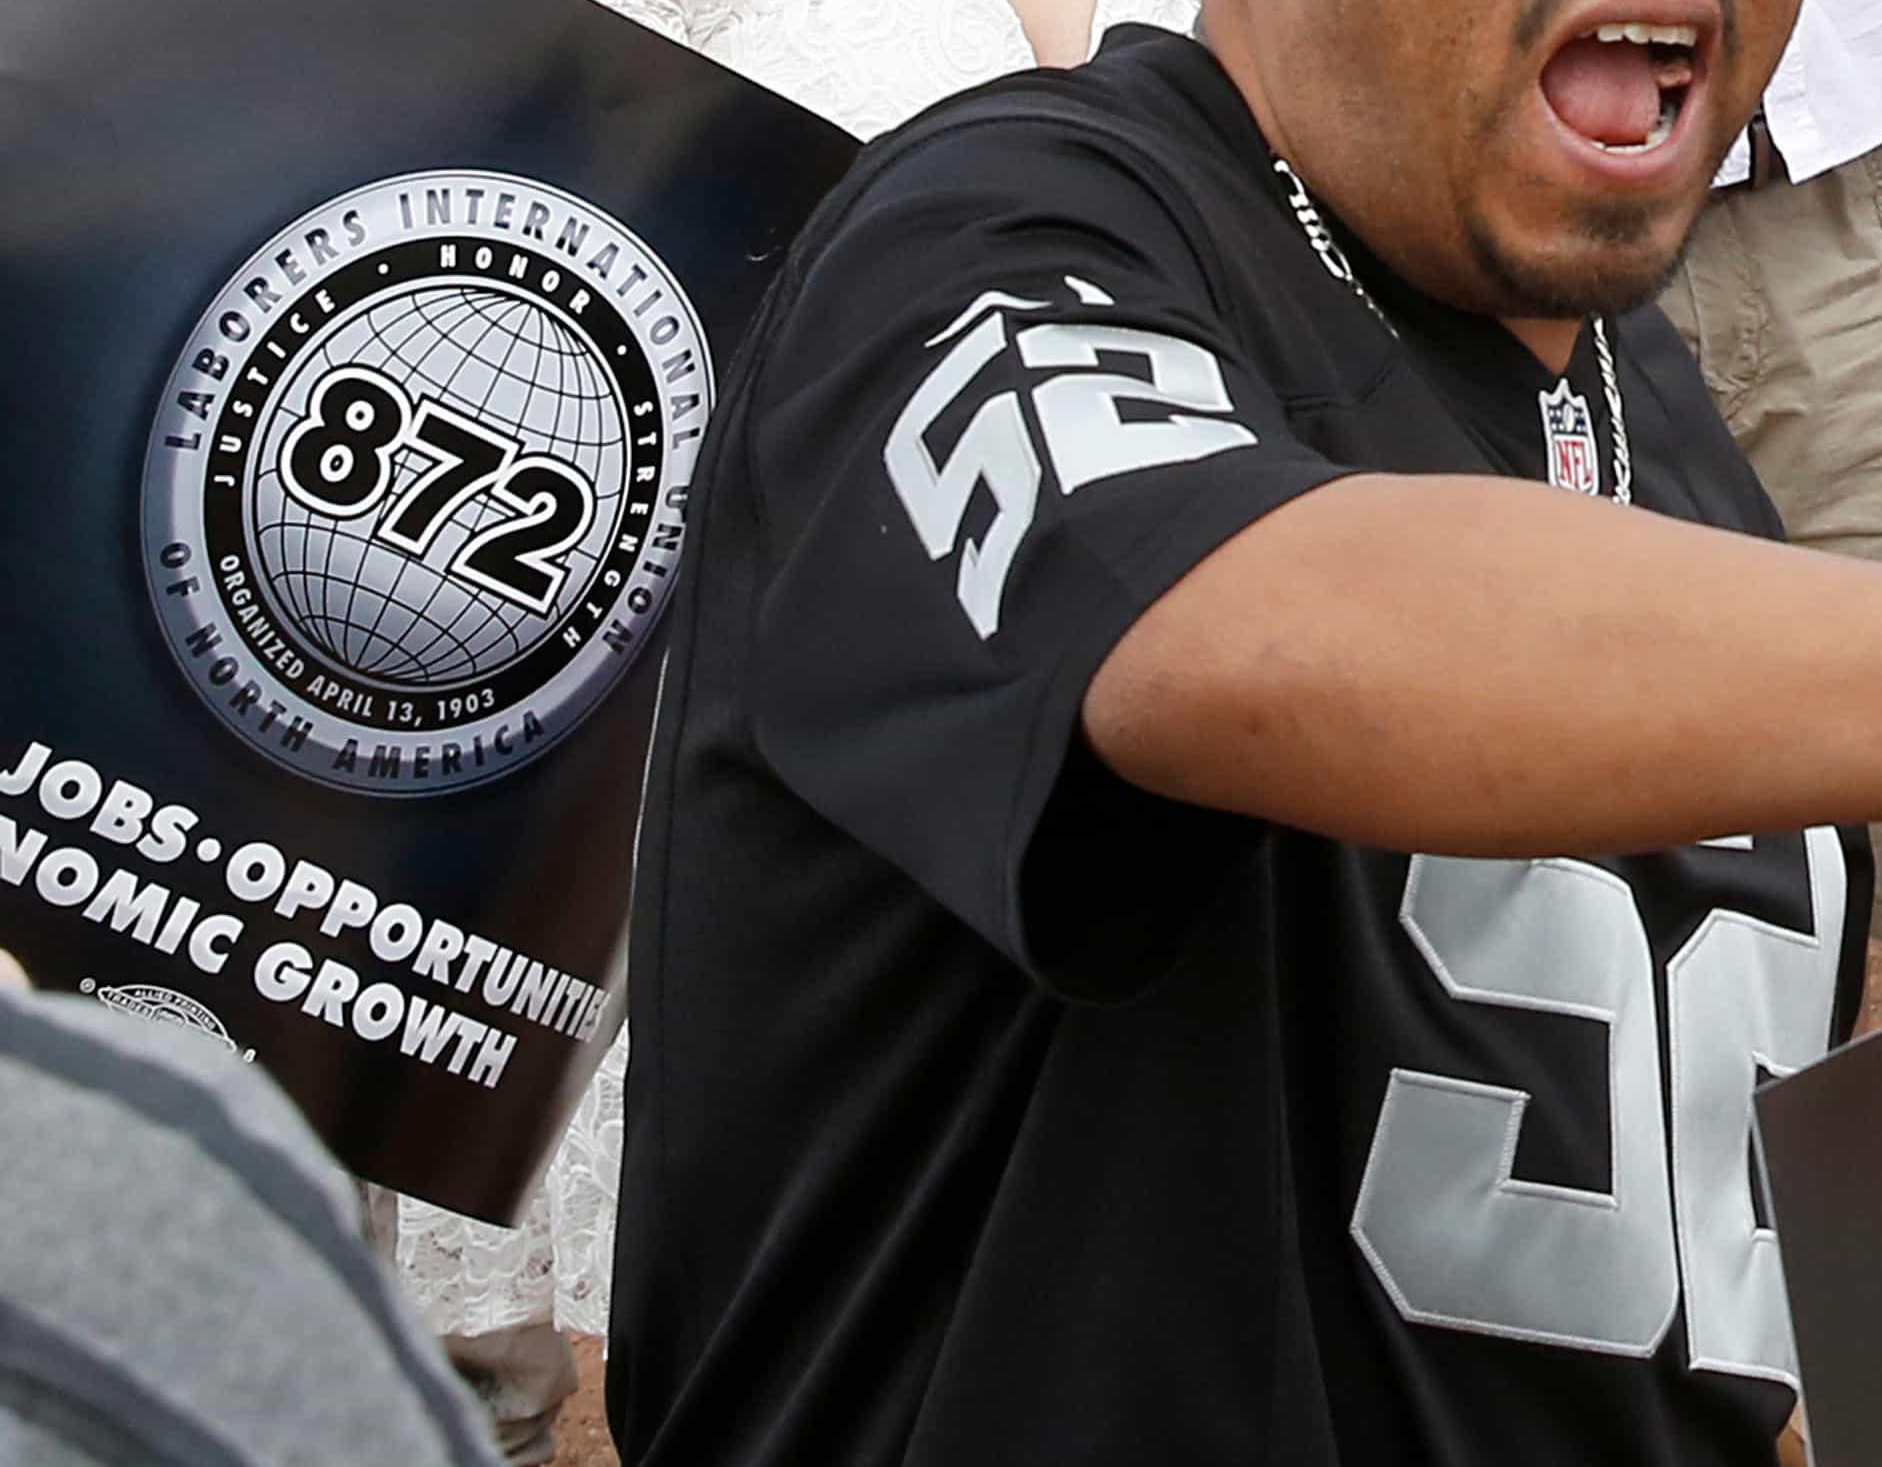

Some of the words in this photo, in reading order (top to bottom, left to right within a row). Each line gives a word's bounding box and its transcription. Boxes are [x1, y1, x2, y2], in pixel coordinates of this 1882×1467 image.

[164, 209, 367, 451] LABORERS
[399, 187, 701, 451] INTERNATIONAL
[602, 485, 689, 655] UNION
[213, 288, 336, 486] JUSTICE
[440, 244, 592, 315] HONOR
[562, 400, 657, 648] STRENGTH
[280, 363, 595, 615] 872
[884, 275, 1258, 641] 52
[1554, 439, 1594, 488] NFL
[160, 541, 199, 600] OF
[184, 622, 314, 753] NORTH
[333, 710, 546, 780] AMERICA
[219, 555, 305, 680] ORGANIZED
[307, 675, 374, 719] APRIL
[387, 699, 423, 728] 13,
[436, 688, 497, 721] 1903
[253, 941, 517, 1089] GROWTH
